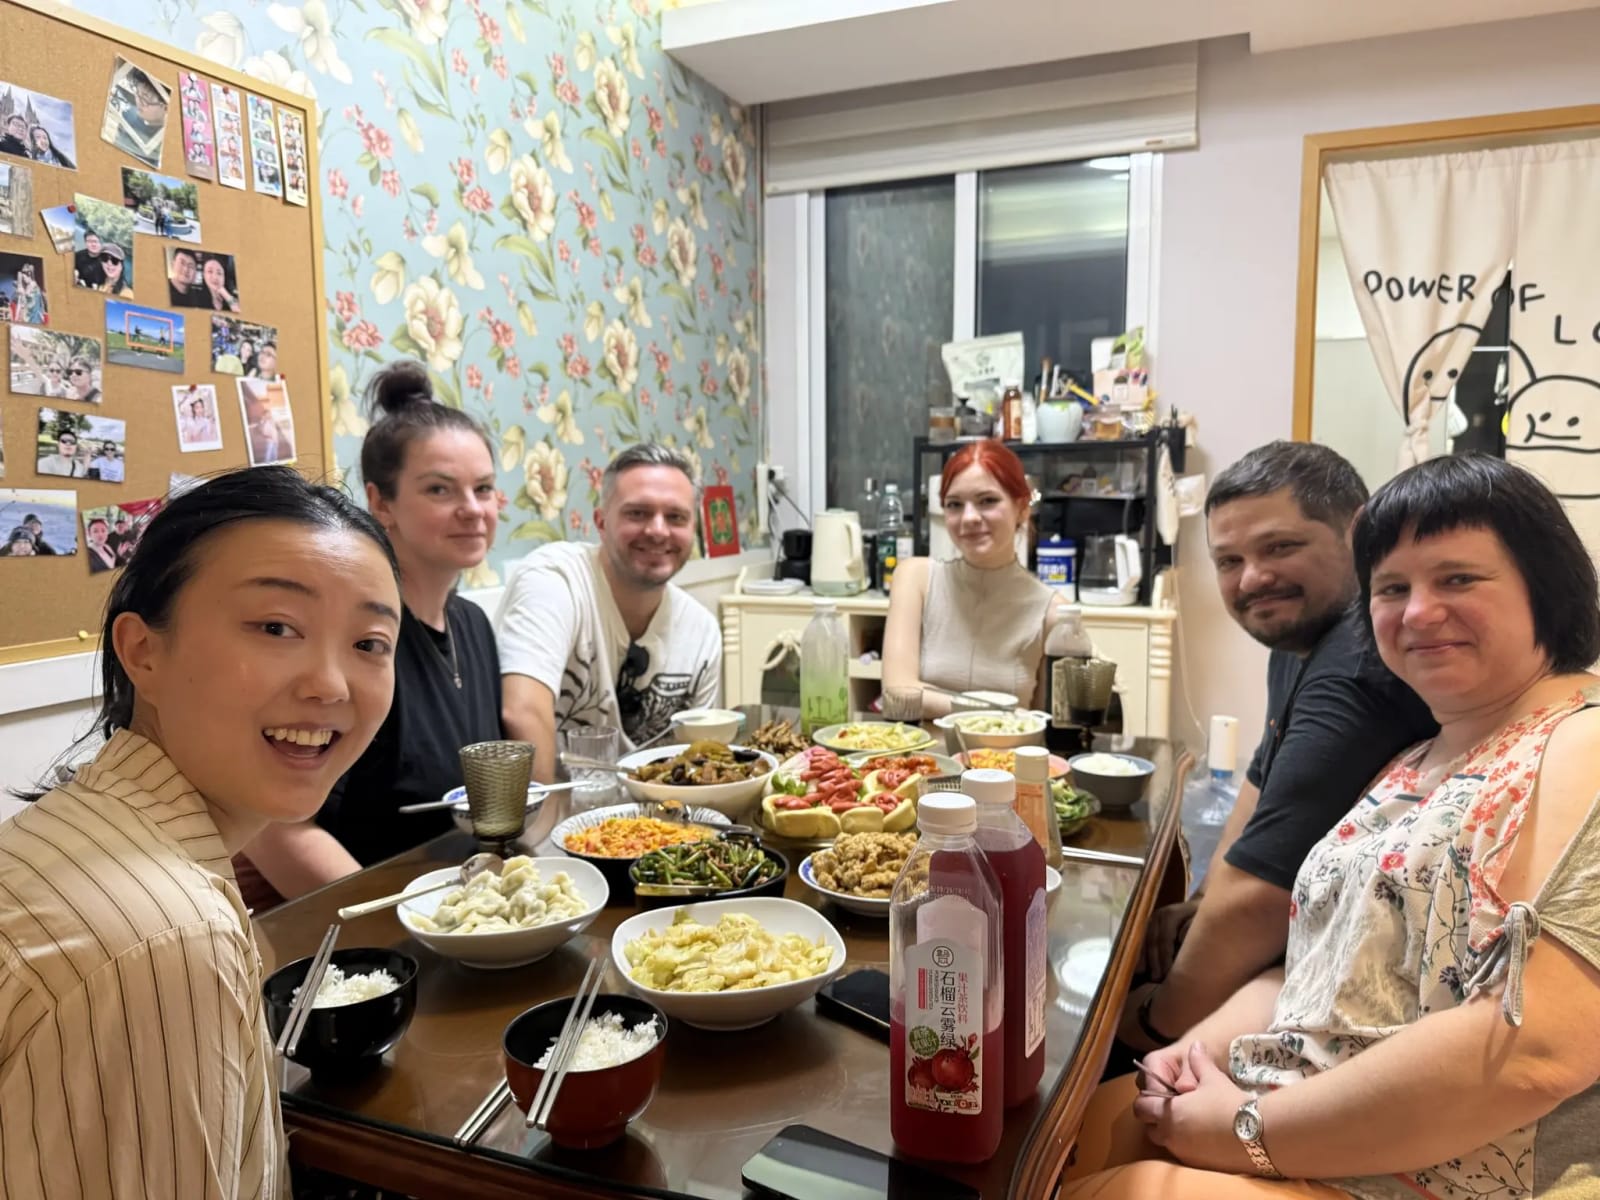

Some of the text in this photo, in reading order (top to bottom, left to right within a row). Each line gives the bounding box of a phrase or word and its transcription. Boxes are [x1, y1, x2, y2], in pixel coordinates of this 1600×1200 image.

[1363, 270, 1477, 304] POWER
[940, 970, 956, 1048] 石榴云雾绿
[957, 971, 969, 1024] 果汁茶饮料
